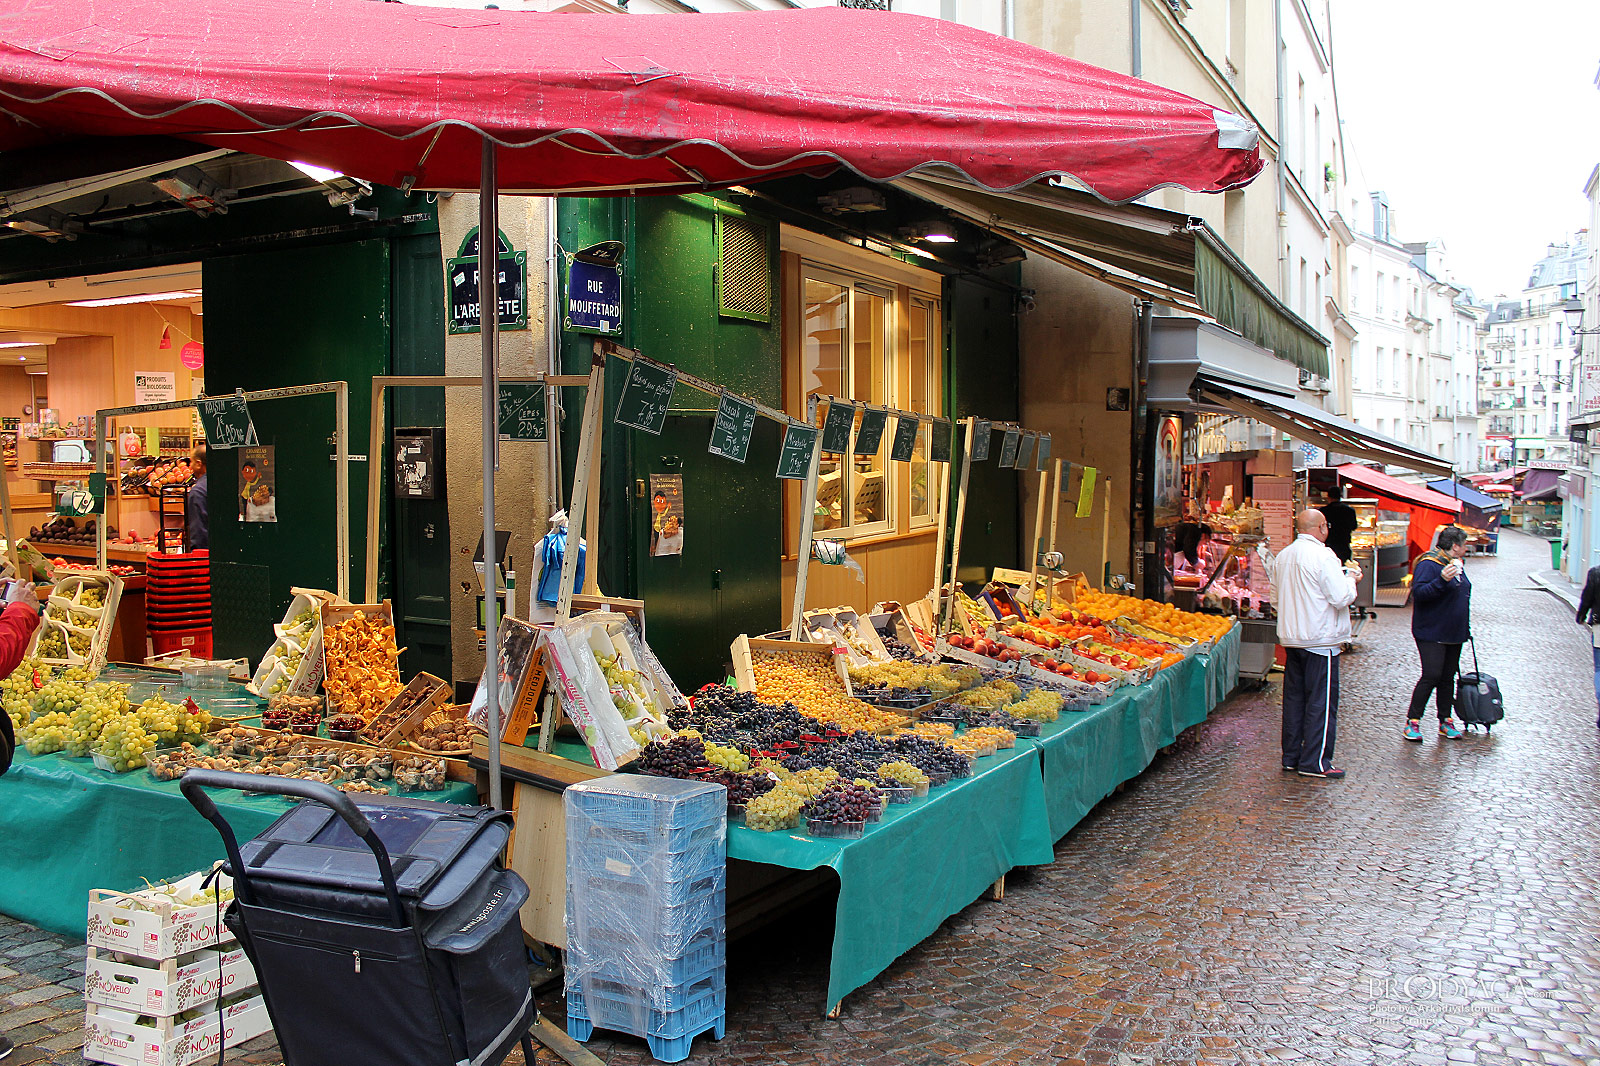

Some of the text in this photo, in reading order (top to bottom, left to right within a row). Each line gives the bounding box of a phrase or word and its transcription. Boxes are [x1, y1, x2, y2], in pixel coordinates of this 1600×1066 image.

[587, 279, 604, 293] RUE
[569, 299, 619, 317] MOUFFETARD
[524, 669, 542, 706] MEDJOOL
[99, 924, 128, 939] NOVELLO
[98, 980, 131, 995] NOVELLO
[96, 1034, 129, 1049] NOVELLO
